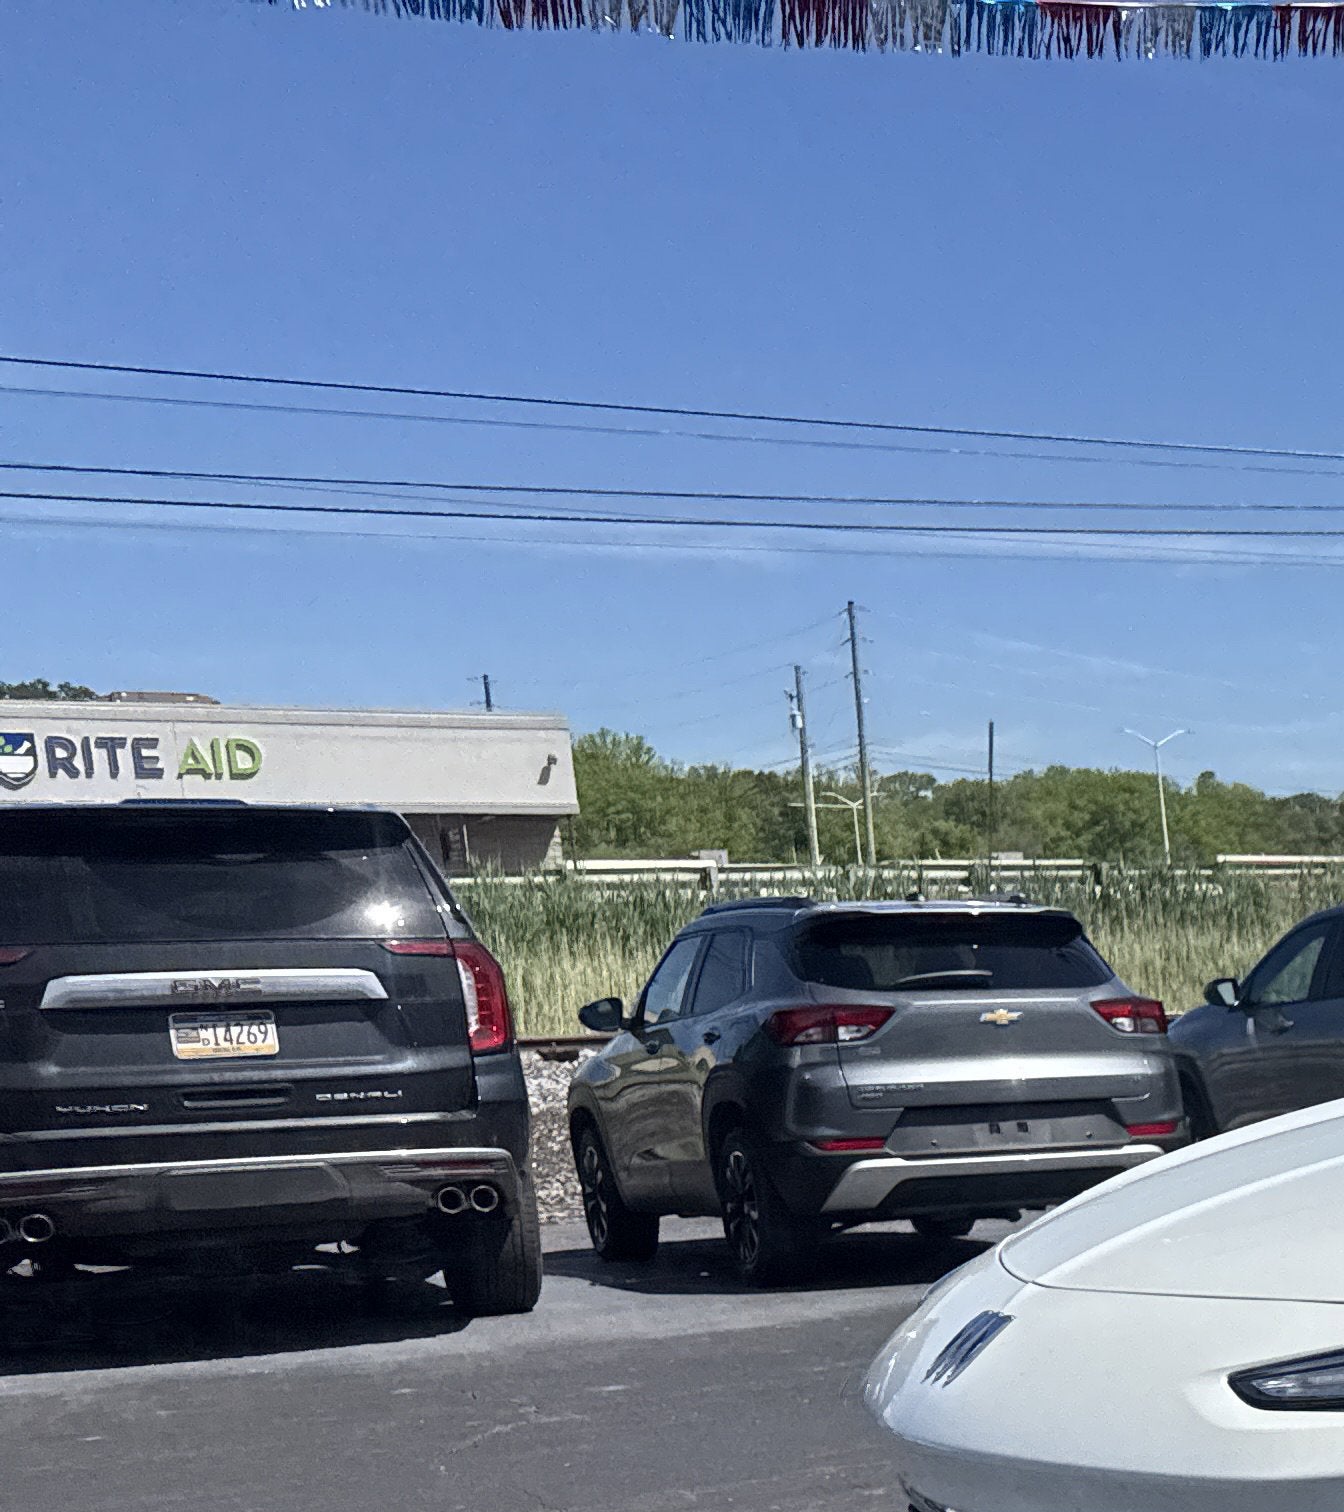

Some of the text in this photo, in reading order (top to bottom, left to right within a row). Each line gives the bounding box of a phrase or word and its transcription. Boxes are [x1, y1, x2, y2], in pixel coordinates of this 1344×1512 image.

[45, 736, 263, 781] RITE AID
[171, 977, 263, 997] GMC
